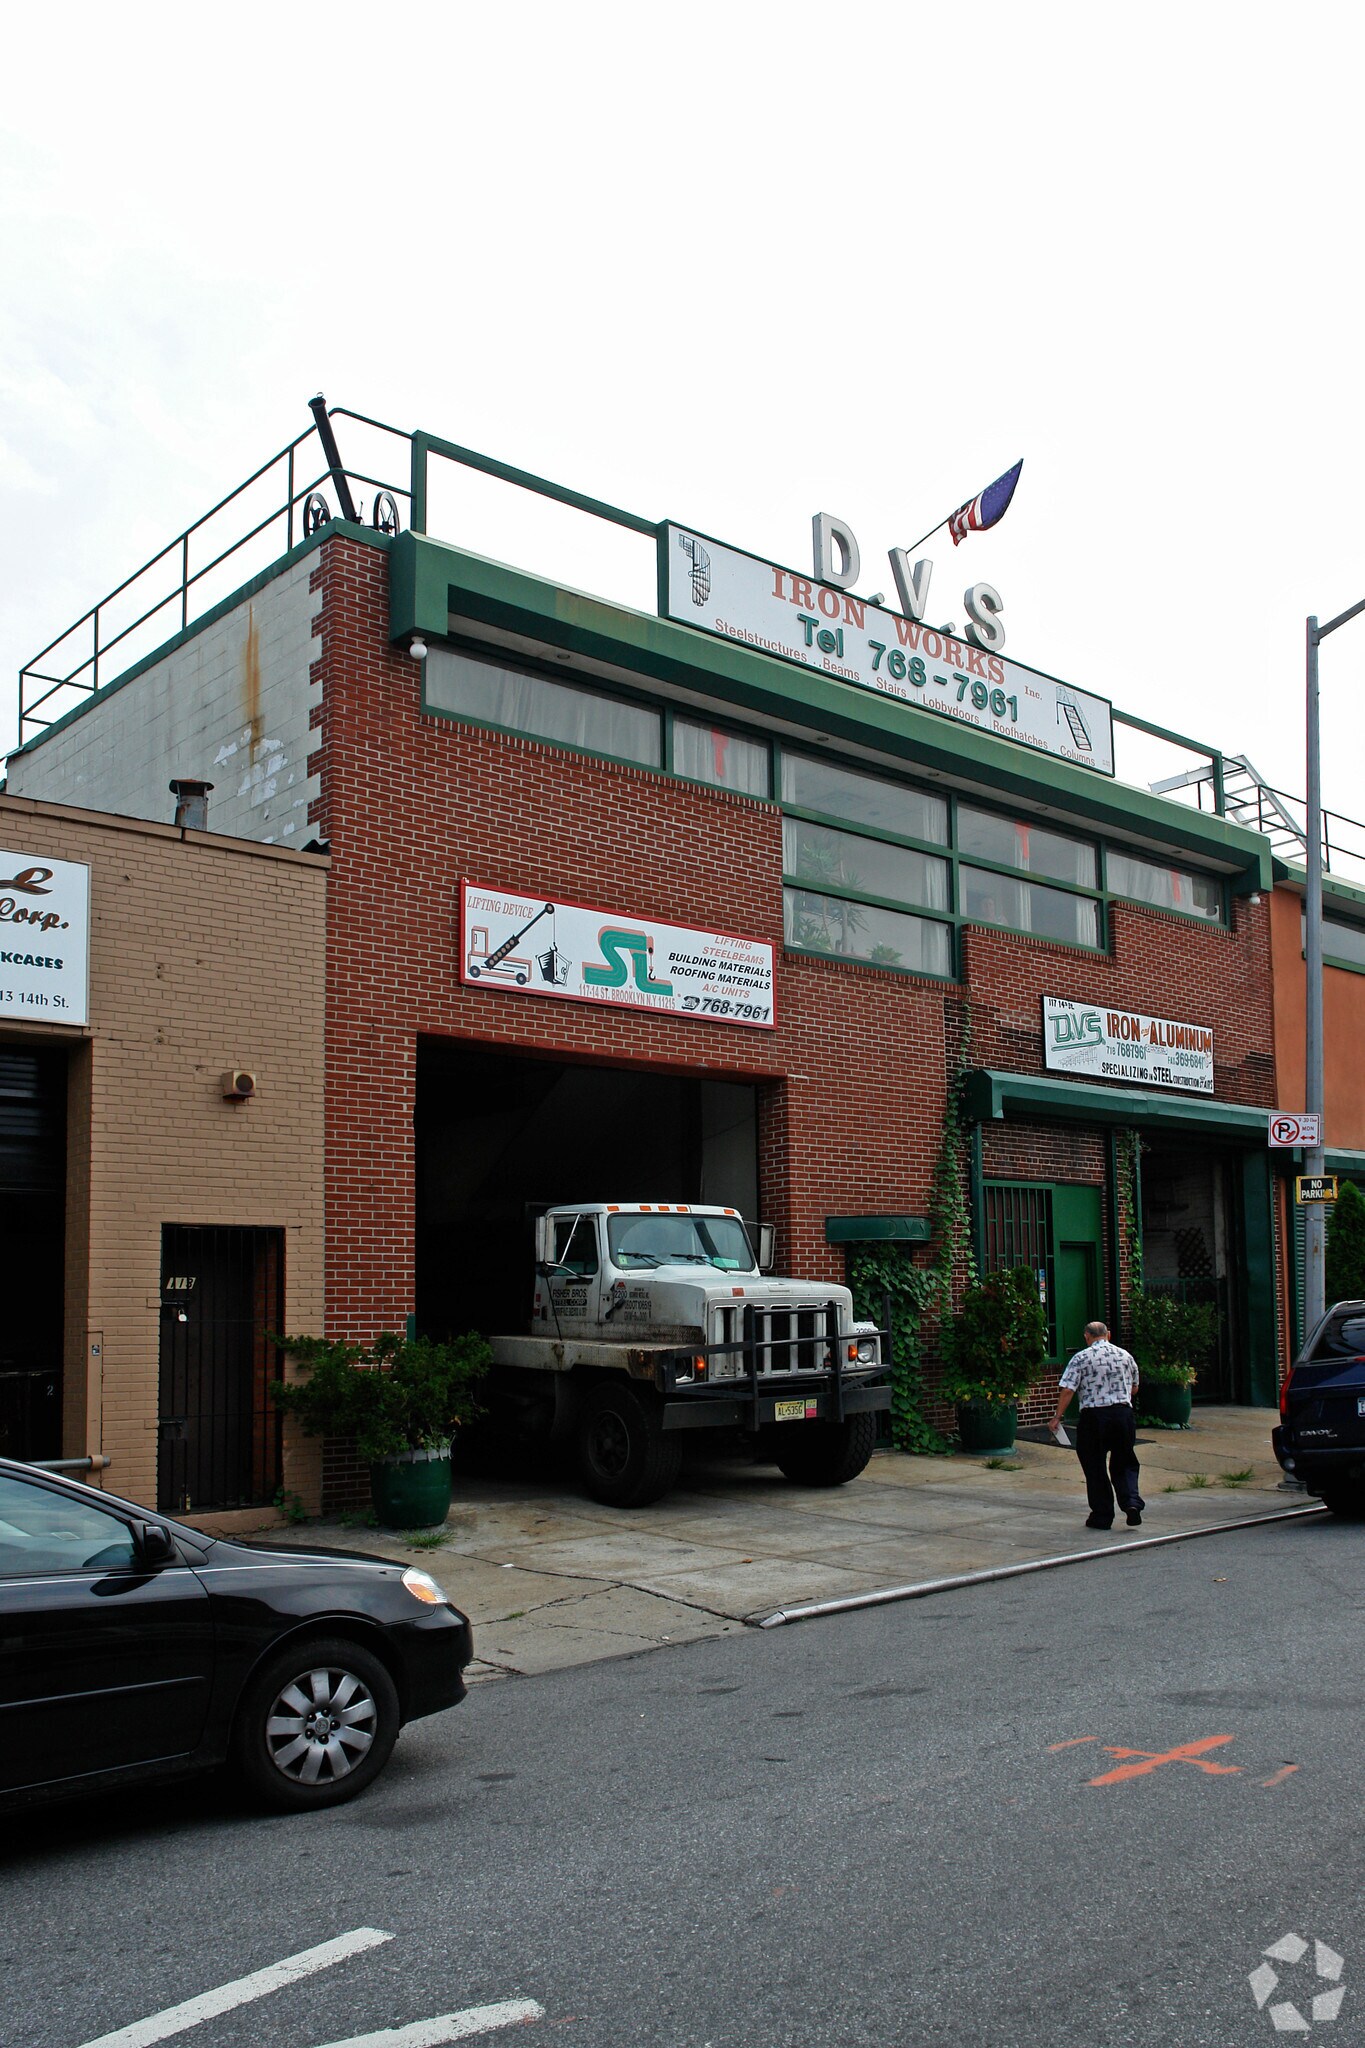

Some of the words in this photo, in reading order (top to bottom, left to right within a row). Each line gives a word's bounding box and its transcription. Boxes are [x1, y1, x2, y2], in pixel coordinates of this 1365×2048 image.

[772, 567, 867, 630] IRON
[892, 614, 1005, 684] WORKS
[1024, 685, 1043, 700] Inc.
[797, 613, 843, 658] Tel
[715, 618, 807, 663] Steelstructures
[876, 676, 907, 698] Stairs
[922, 693, 980, 725] Lobbydoors
[993, 719, 1048, 750] Roofhatches
[1060, 745, 1096, 767] Columns
[0, 897, 69, 932] Corp.
[467, 895, 502, 913] LIFTING
[501, 902, 534, 919] DEVICE
[714, 936, 753, 950] LIFTING
[668, 952, 717, 968] BUILDING
[718, 960, 772, 978] MATERIALS
[702, 946, 765, 965] STEELBEAMS
[670, 965, 716, 981] ROOFING
[717, 974, 771, 990] MATERIALS
[18, 992, 48, 1006] 14th
[53, 994, 70, 1009] St.
[578, 984, 600, 997] 117-14
[611, 989, 645, 1006] BROOKLYN
[658, 996, 676, 1010] 11215
[702, 983, 719, 993] A/C
[721, 986, 750, 998] UNITS
[702, 997, 770, 1021] 768-7961
[1106, 1012, 1140, 1042] IRON
[1150, 1021, 1212, 1053] ALUMINUM
[1101, 1062, 1149, 1080] SPECIALIZING
[1153, 1066, 1173, 1084] STEEL
[1173, 1075, 1200, 1087] CONSTRUCTION
[1311, 1180, 1322, 1188] NO
[552, 1288, 570, 1298] FISHER
[614, 1290, 628, 1299] 2200
